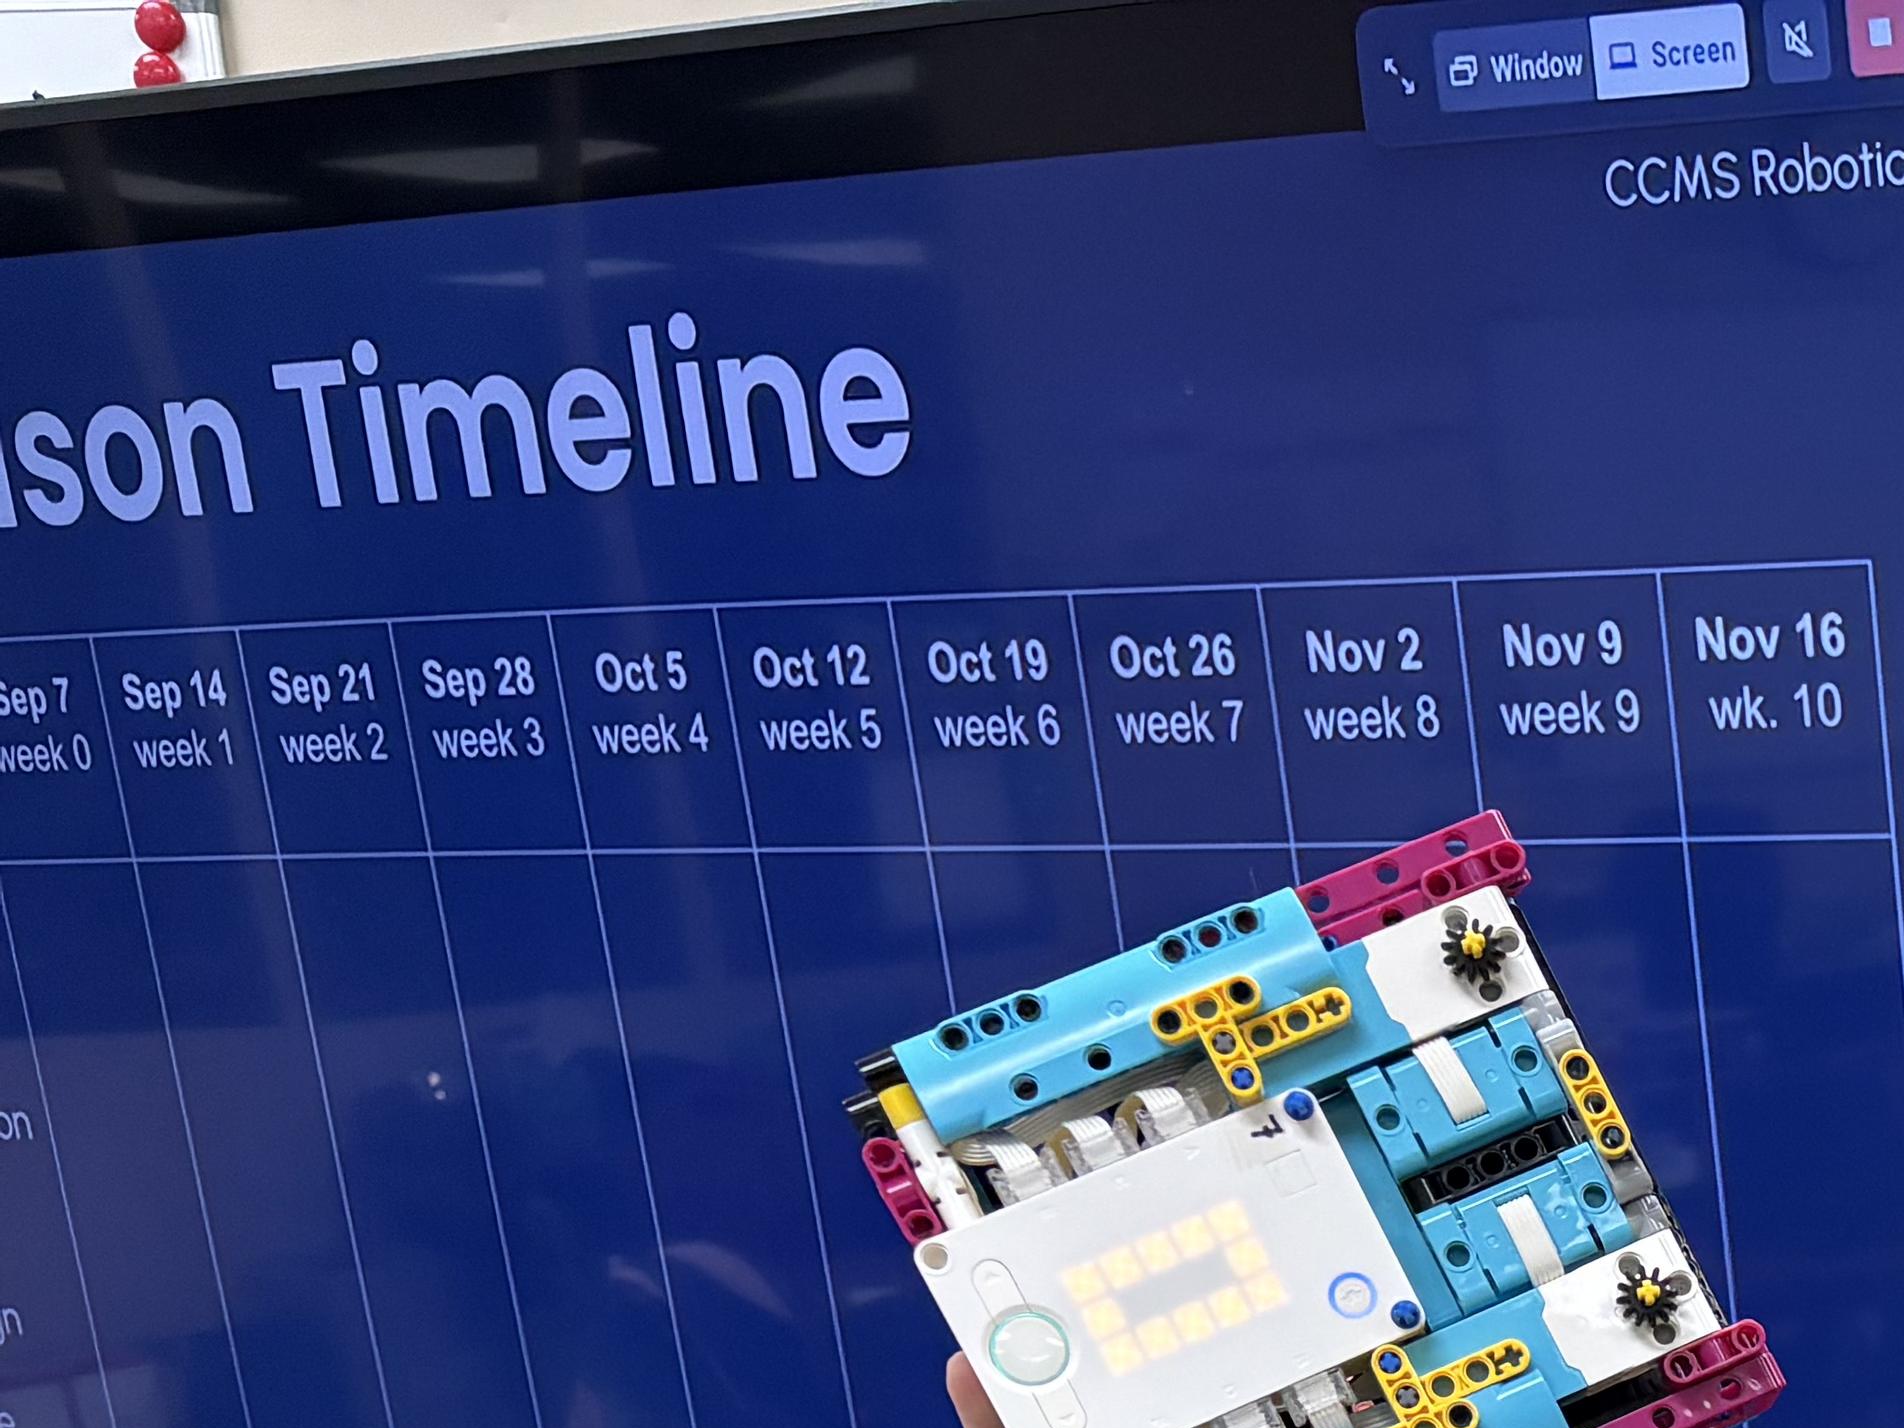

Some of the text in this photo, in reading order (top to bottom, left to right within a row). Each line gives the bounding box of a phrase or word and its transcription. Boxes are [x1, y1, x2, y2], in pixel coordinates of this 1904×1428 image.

[1489, 48, 1583, 86] Window
[1650, 35, 1737, 69] Screen
[1604, 150, 1741, 209] CCMS
[0, 311, 911, 528] son Timeline
[1109, 631, 1235, 680] Oct 26
[1305, 626, 1423, 674] Nov 2
[1501, 619, 1622, 668] Nov 9
[1694, 611, 1846, 662] Nov 16
[421, 656, 535, 704] Sep 28
[595, 650, 688, 695] Oct 5
[752, 643, 871, 691] Oct 12
[927, 638, 1049, 686] Oct 19
[53, 677, 69, 713] 7
[122, 667, 227, 718] Sep 14
[270, 662, 376, 711] Sep 21
[1709, 682, 1842, 732] wk. 10
[592, 712, 709, 758] week 4
[760, 706, 882, 755] week 5
[933, 702, 1061, 750] week 6
[1115, 697, 1245, 746] week 7
[1304, 691, 1440, 741] week 8
[1499, 687, 1640, 736] week 9
[72, 732, 91, 771] 0
[134, 727, 233, 769] week 1
[279, 722, 389, 765] week 2
[432, 716, 546, 760] week 3
